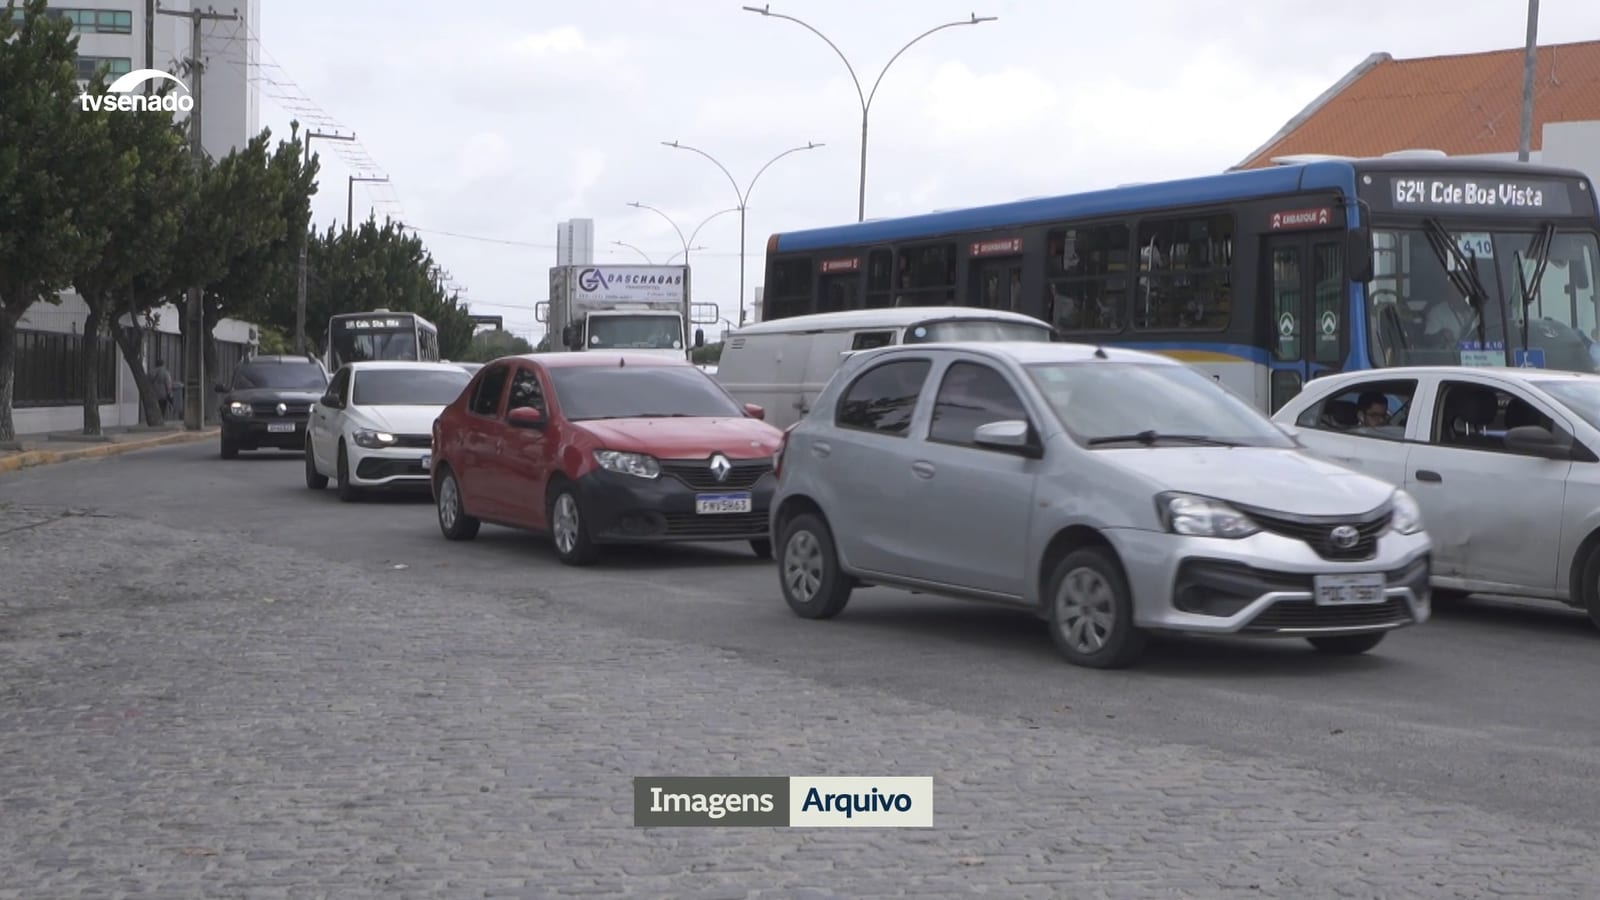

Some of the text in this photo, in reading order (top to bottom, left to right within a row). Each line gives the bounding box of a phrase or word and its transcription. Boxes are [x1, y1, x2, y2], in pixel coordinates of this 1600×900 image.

[1396, 180, 1543, 206] 624 Cde Boa Vista
